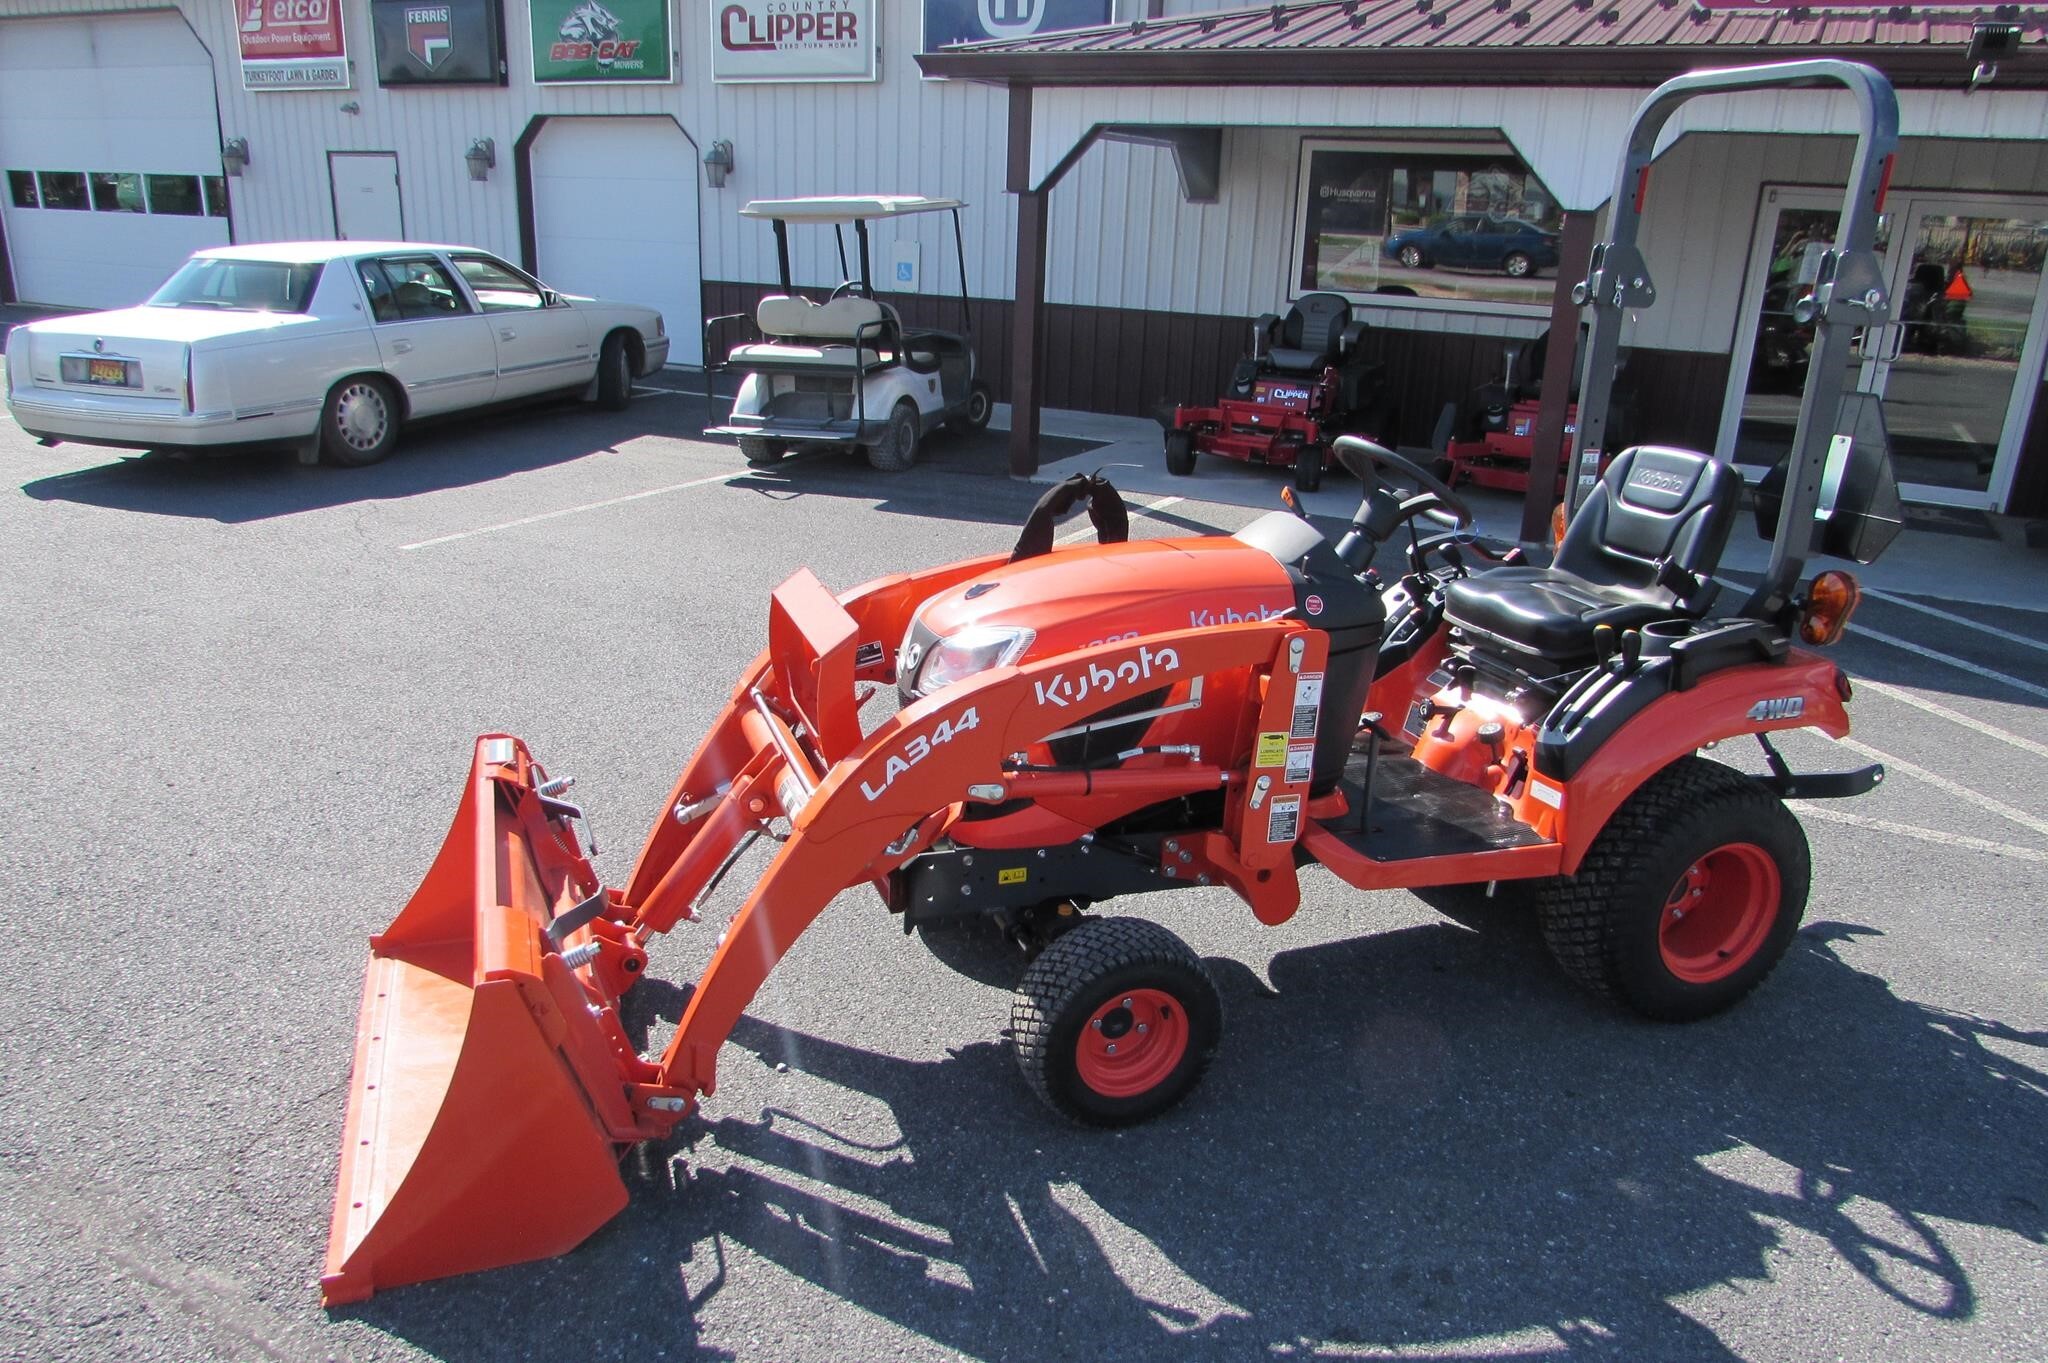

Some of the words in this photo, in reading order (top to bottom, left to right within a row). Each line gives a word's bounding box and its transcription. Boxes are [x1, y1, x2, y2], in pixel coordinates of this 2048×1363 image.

[766, 1, 850, 13] COUNTRY
[408, 8, 448, 24] FERRIS
[721, 4, 857, 51] CLIPPER
[242, 34, 270, 44] Outdoor
[271, 33, 292, 43] Power
[292, 32, 331, 44] Equipment
[614, 60, 644, 69] MOWERS
[244, 70, 285, 82] TURKEYFOOT
[287, 69, 304, 81] LAWN
[306, 69, 311, 80] &
[312, 69, 338, 80] GARDEN
[1034, 646, 1180, 707] Kubota
[1746, 697, 1804, 721] 4WD
[860, 706, 980, 801] LA344
